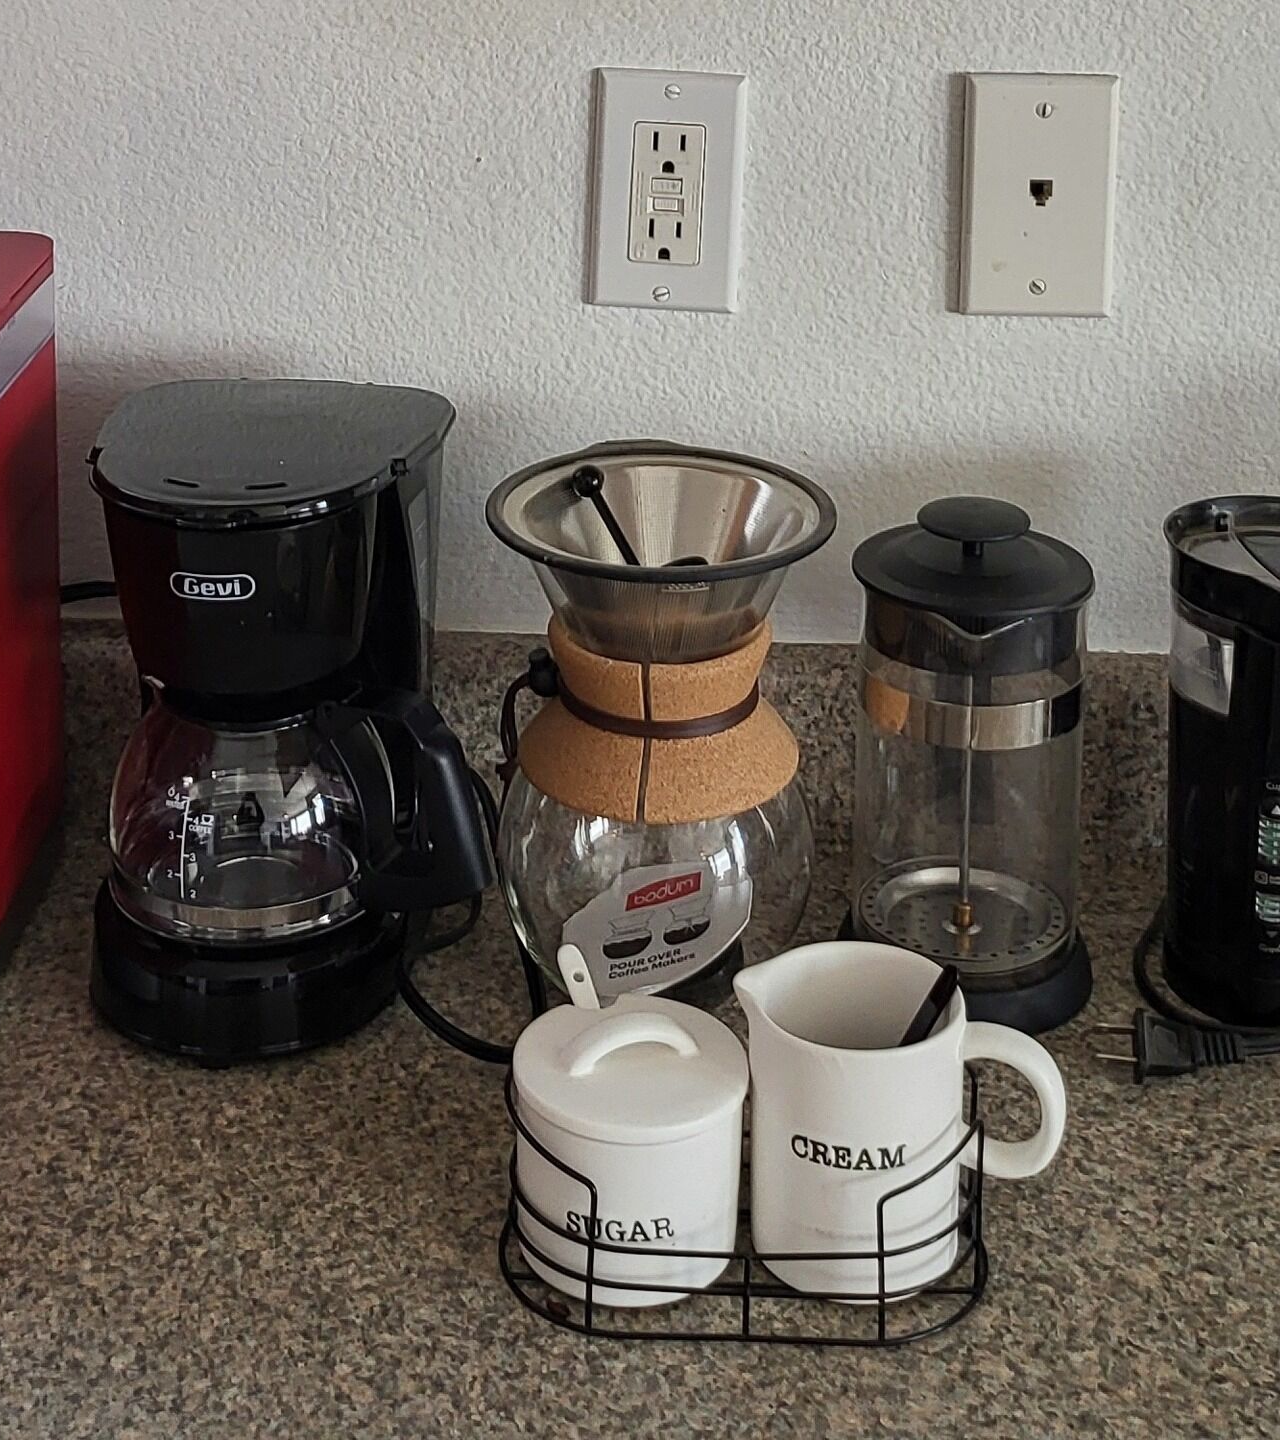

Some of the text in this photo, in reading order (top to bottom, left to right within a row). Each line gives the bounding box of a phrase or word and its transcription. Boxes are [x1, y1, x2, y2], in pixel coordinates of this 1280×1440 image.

[183, 577, 241, 596] Gevi
[168, 830, 174, 840] 3
[189, 853, 196, 861] 3
[167, 869, 173, 879] 2
[190, 889, 196, 899] 2
[634, 878, 694, 905] bodum
[608, 952, 696, 979] Coffee Makers
[609, 948, 682, 971] POUR OVER
[790, 1134, 906, 1172] CREAM
[565, 1210, 674, 1243] SUGAR
